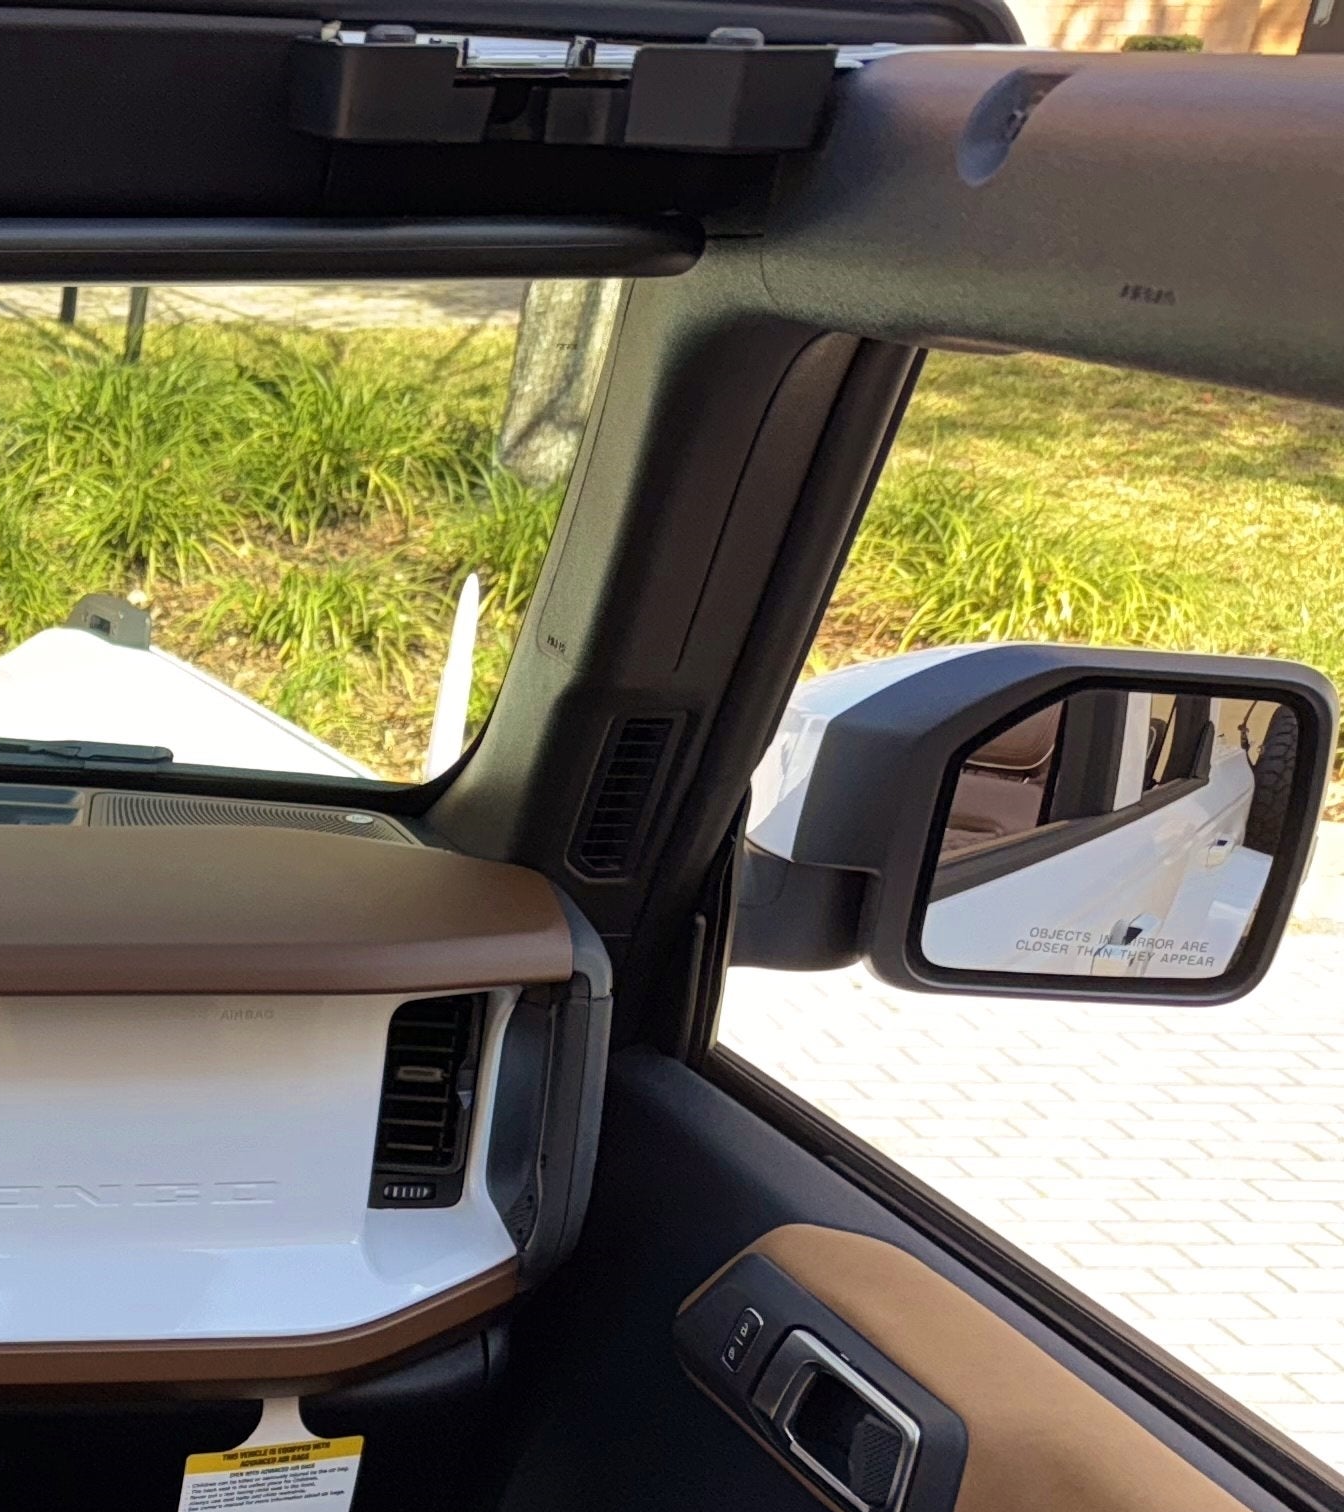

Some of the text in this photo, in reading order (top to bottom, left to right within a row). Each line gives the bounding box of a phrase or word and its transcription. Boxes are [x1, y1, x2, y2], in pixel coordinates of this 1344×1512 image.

[1015, 939, 1215, 967] CLOSER THAN THEY APPEAR
[1029, 926, 1092, 943] OBJECTS
[1098, 933, 1112, 945] IN
[1180, 940, 1210, 953] ARE
